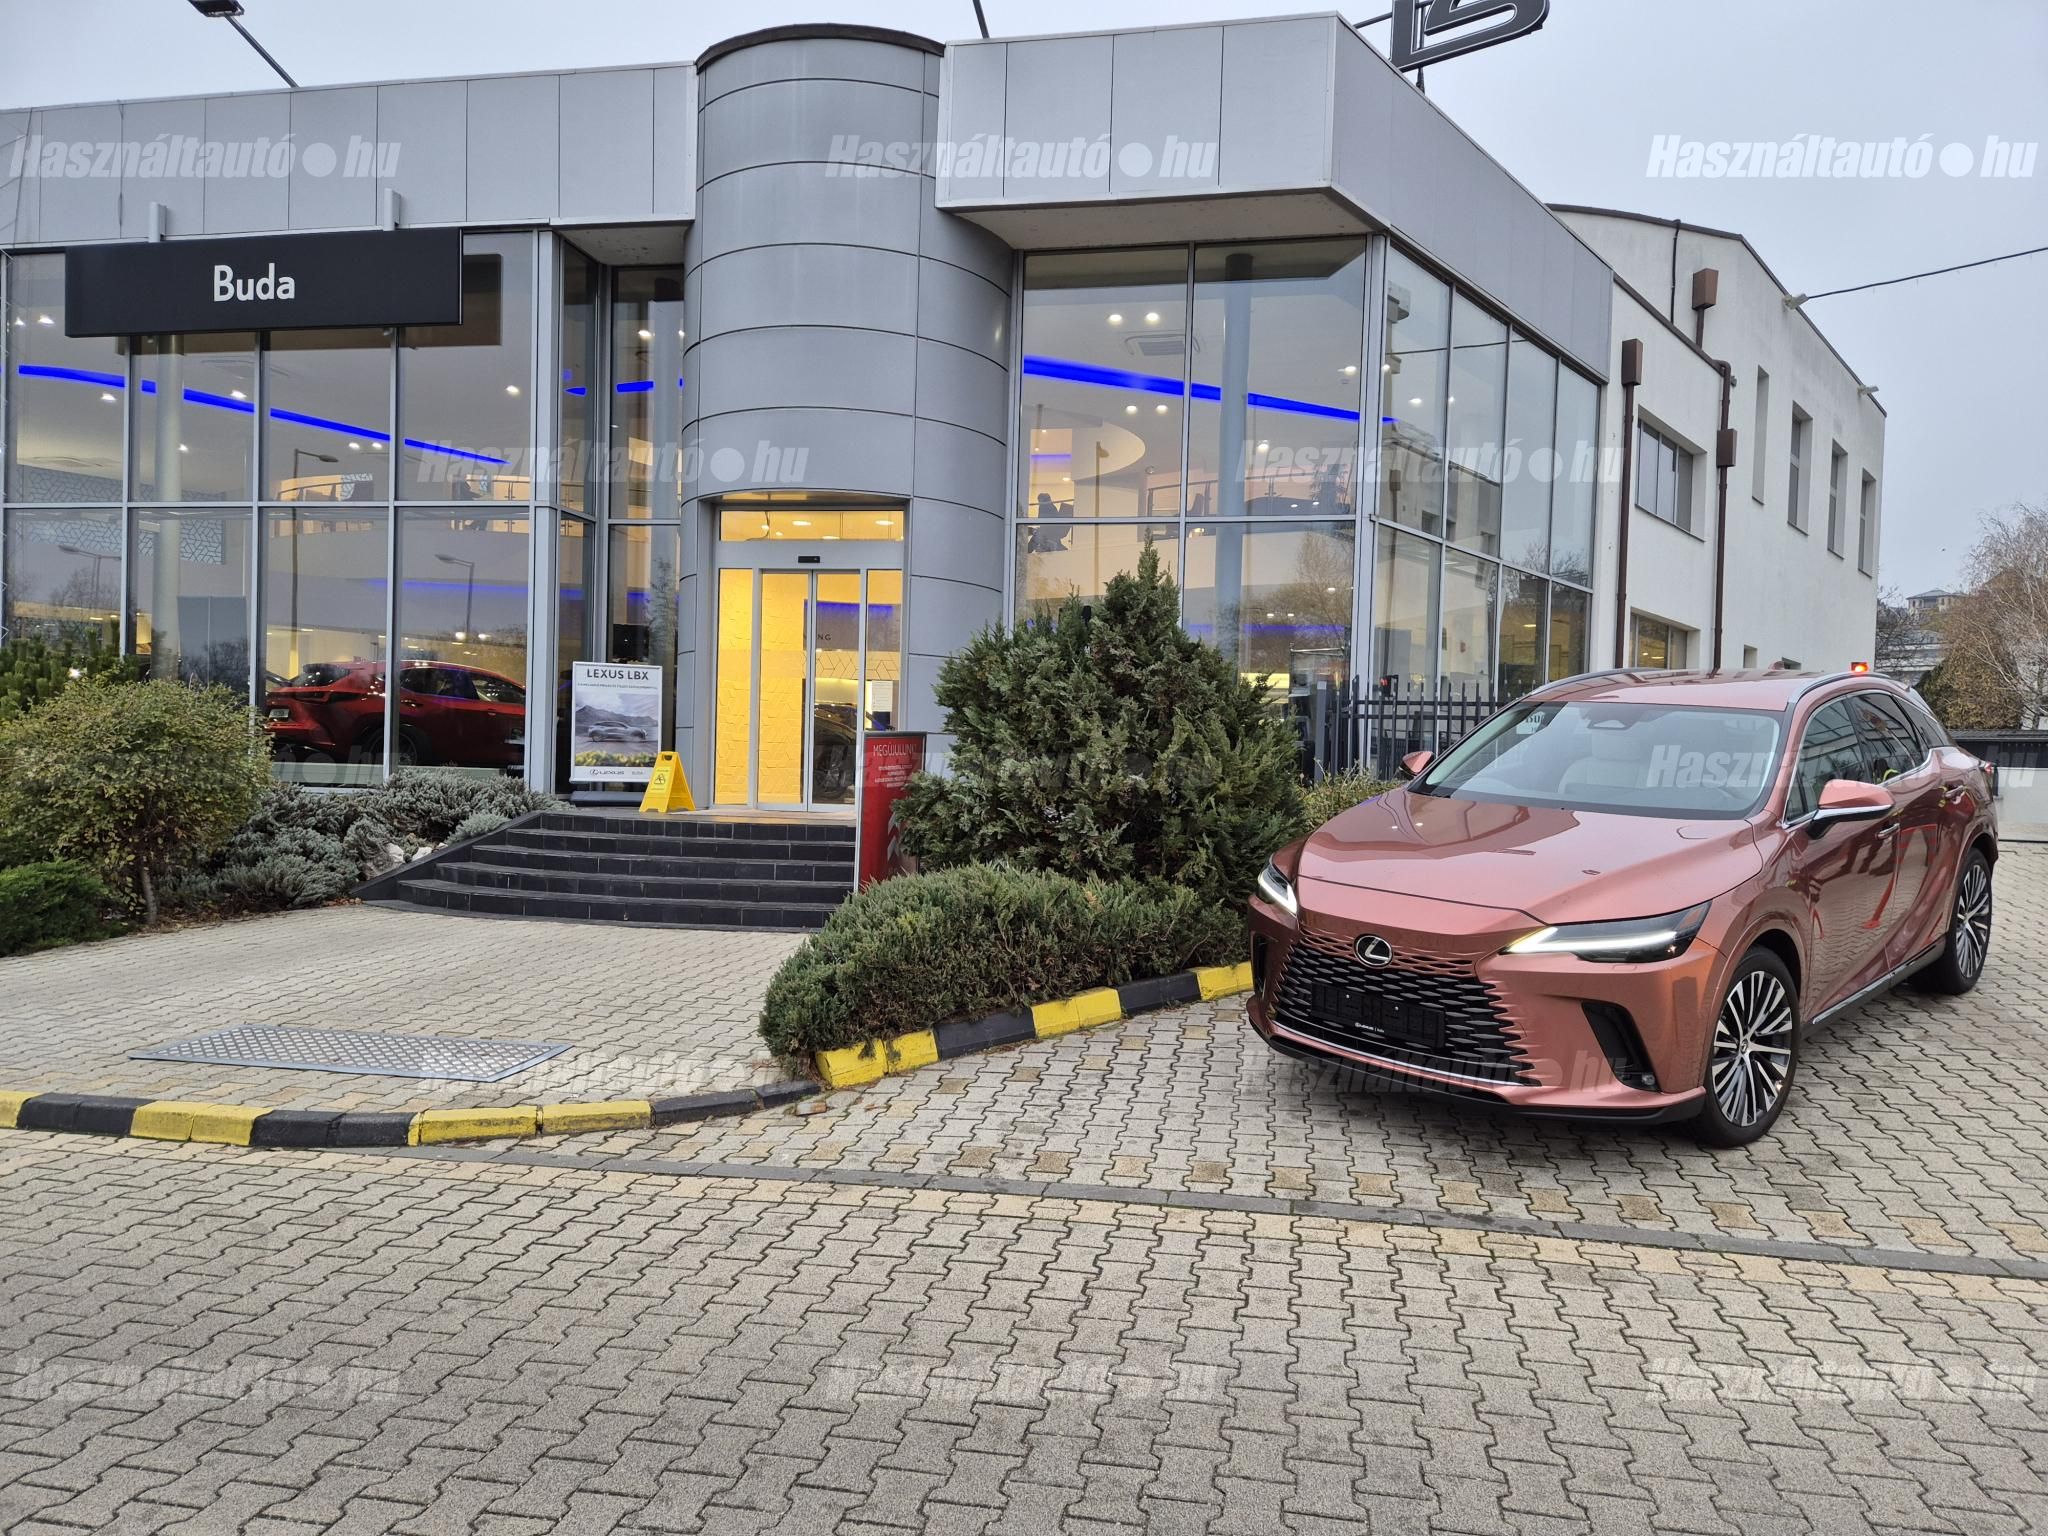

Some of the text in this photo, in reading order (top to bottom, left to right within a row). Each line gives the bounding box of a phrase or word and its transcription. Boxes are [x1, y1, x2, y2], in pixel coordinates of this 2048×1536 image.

[214, 262, 295, 302] Buda
[587, 668, 649, 681] LEXUS LBX
